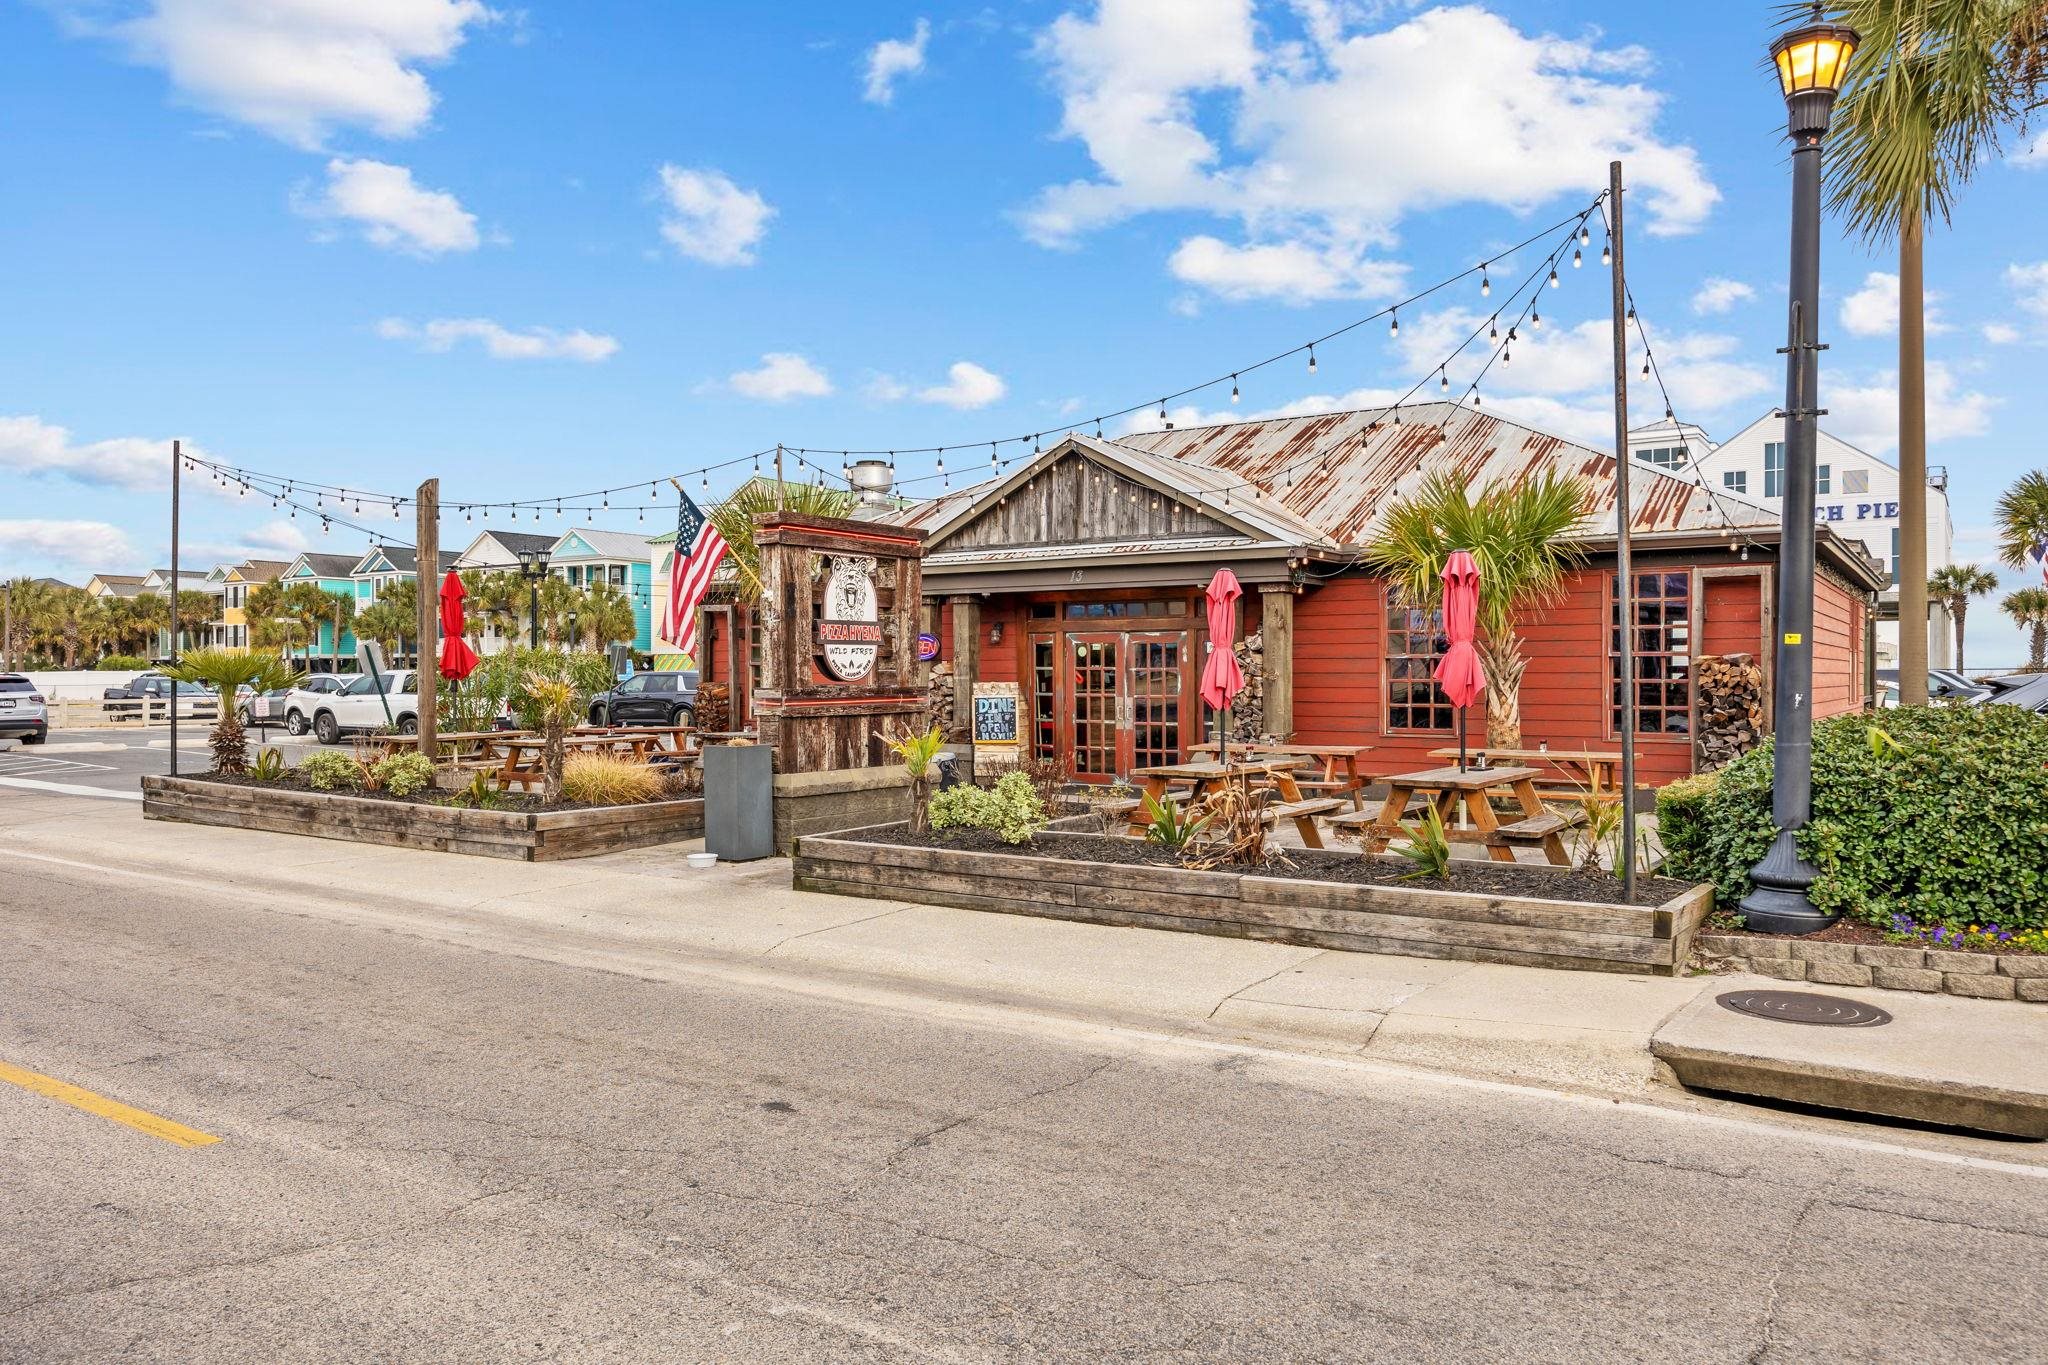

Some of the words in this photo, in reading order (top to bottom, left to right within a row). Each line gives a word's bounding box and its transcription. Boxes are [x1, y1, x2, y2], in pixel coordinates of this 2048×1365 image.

[1070, 570, 1083, 582] 13
[820, 623, 849, 640] PIZZA
[850, 625, 881, 641] HYENA
[829, 647, 847, 655] WILD
[918, 640, 937, 654] PEN
[978, 698, 1016, 713] DINE
[985, 713, 1003, 723] IN
[980, 722, 1009, 733] OPEN
